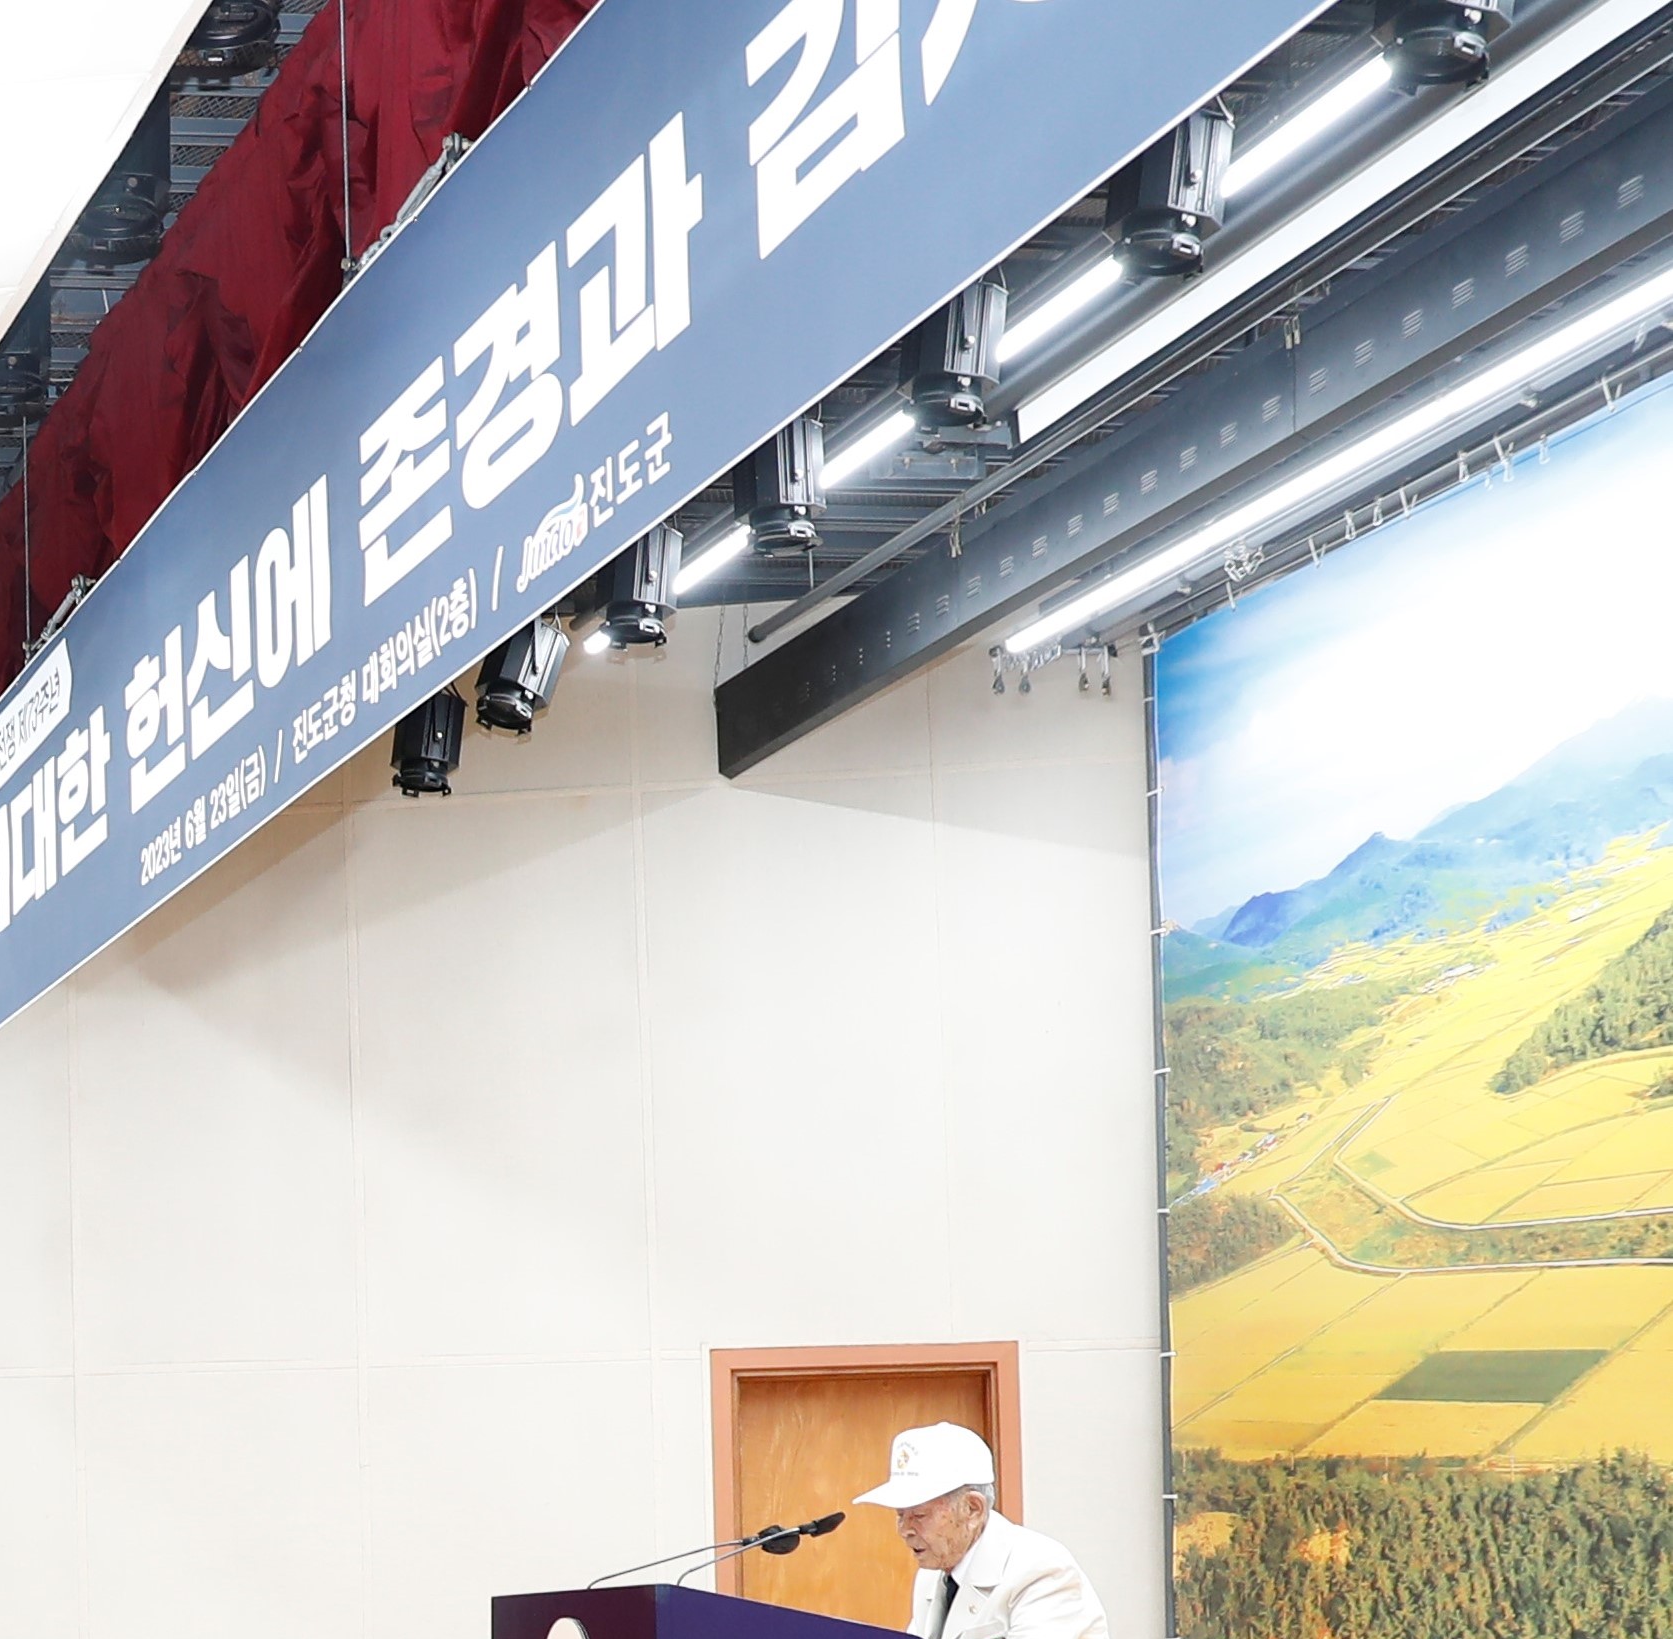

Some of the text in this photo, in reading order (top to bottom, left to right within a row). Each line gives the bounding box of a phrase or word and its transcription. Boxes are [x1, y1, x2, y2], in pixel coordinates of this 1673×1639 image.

[124, 474, 332, 815] 헌신에
[359, 111, 704, 607] 존경과
[140, 816, 182, 886] 2023년
[185, 795, 207, 850] 6월
[210, 744, 266, 830] 23일(금)
[292, 670, 357, 765] 진도군청
[362, 567, 478, 705] 대회의실(2층)
[589, 411, 674, 528] 진도군
